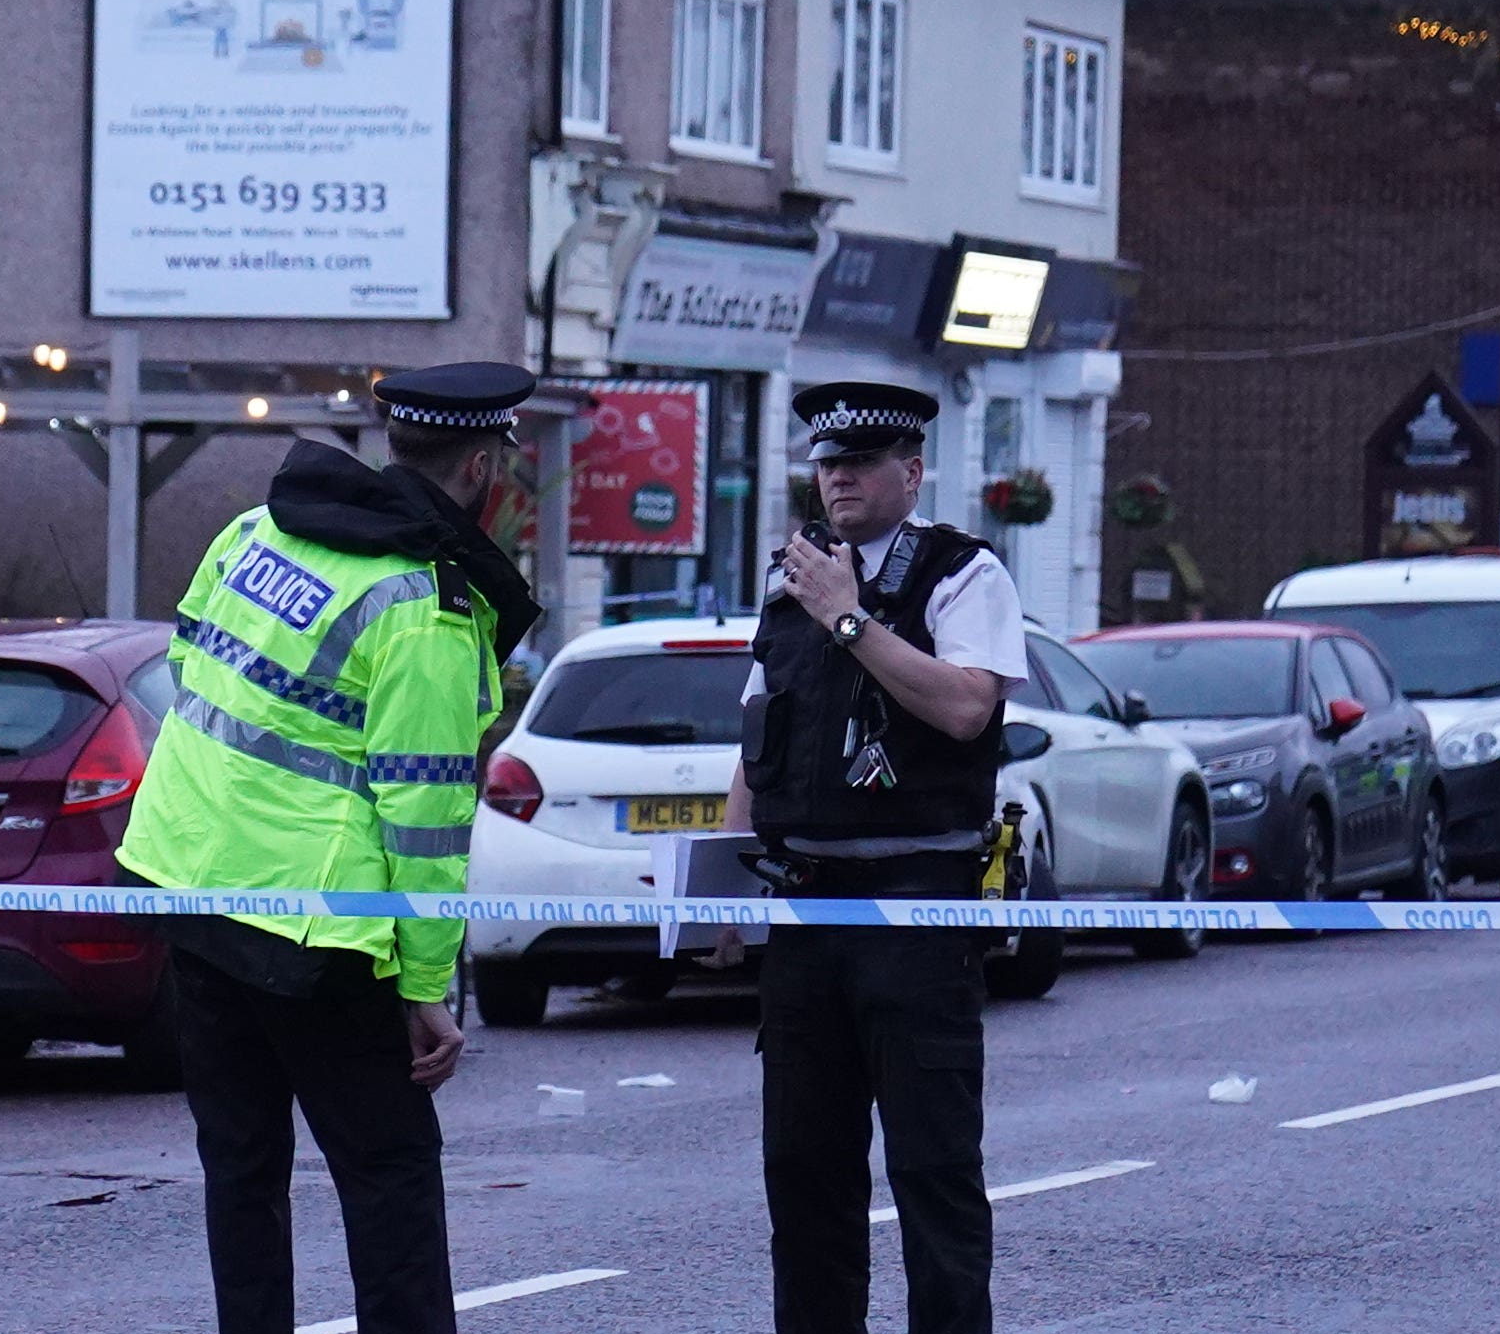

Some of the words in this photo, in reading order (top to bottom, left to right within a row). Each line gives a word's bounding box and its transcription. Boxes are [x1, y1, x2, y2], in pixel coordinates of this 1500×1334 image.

[149, 180, 227, 213] 0151
[237, 174, 301, 213] 639
[309, 181, 388, 213] 5333
[165, 248, 373, 271] www.skellens.com
[229, 548, 326, 625] POLICE
[636, 799, 694, 826] MC16
[699, 798, 725, 826] D
